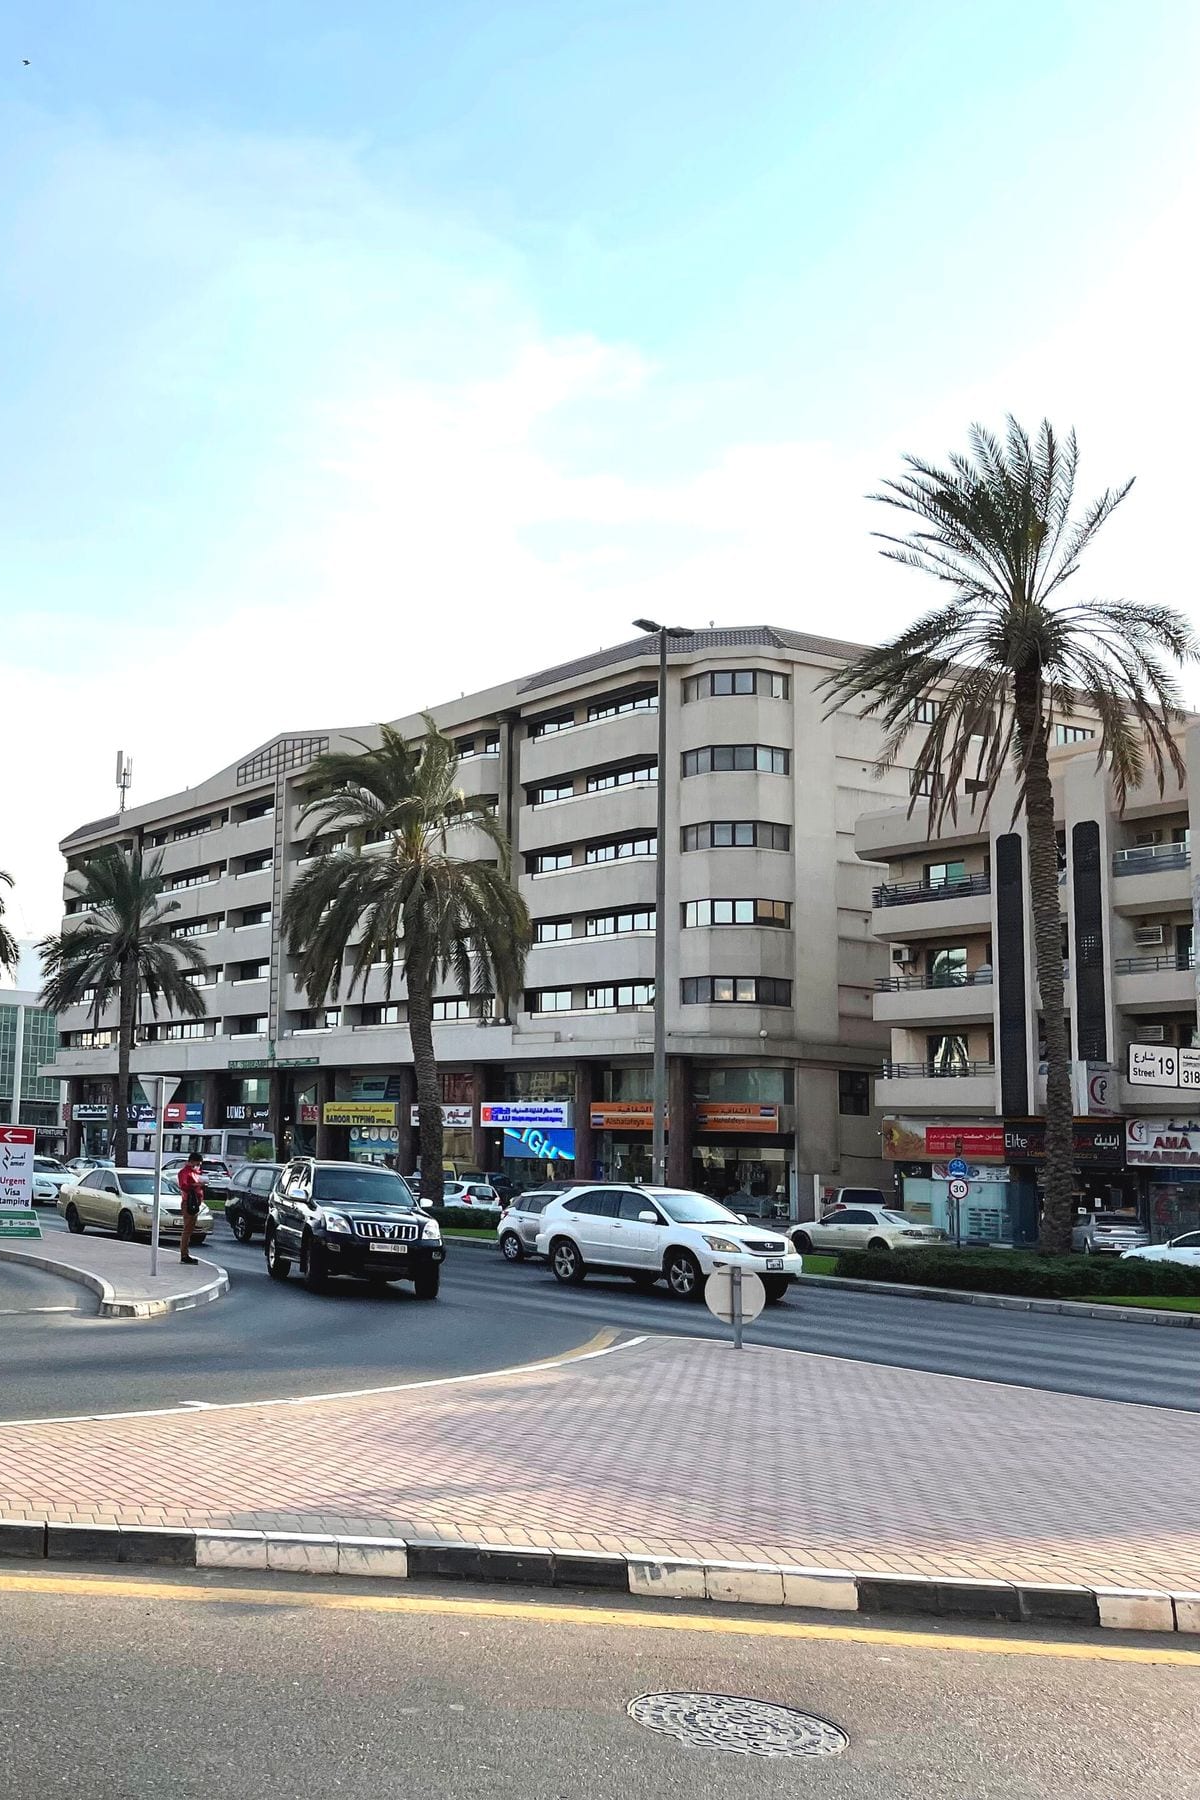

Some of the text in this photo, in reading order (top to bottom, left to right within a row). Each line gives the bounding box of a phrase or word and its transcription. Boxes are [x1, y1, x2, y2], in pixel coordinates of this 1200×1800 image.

[1134, 1051, 1155, 1063] شارع
[1133, 1067, 1156, 1078] Street
[1158, 1056, 1175, 1076] 19
[351, 1114, 376, 1124] TYPING
[1004, 1132, 1028, 1149] Elite
[0, 1176, 26, 1187] Urgent
[4, 1187, 20, 1196] Visa
[953, 1184, 965, 1193] 30
